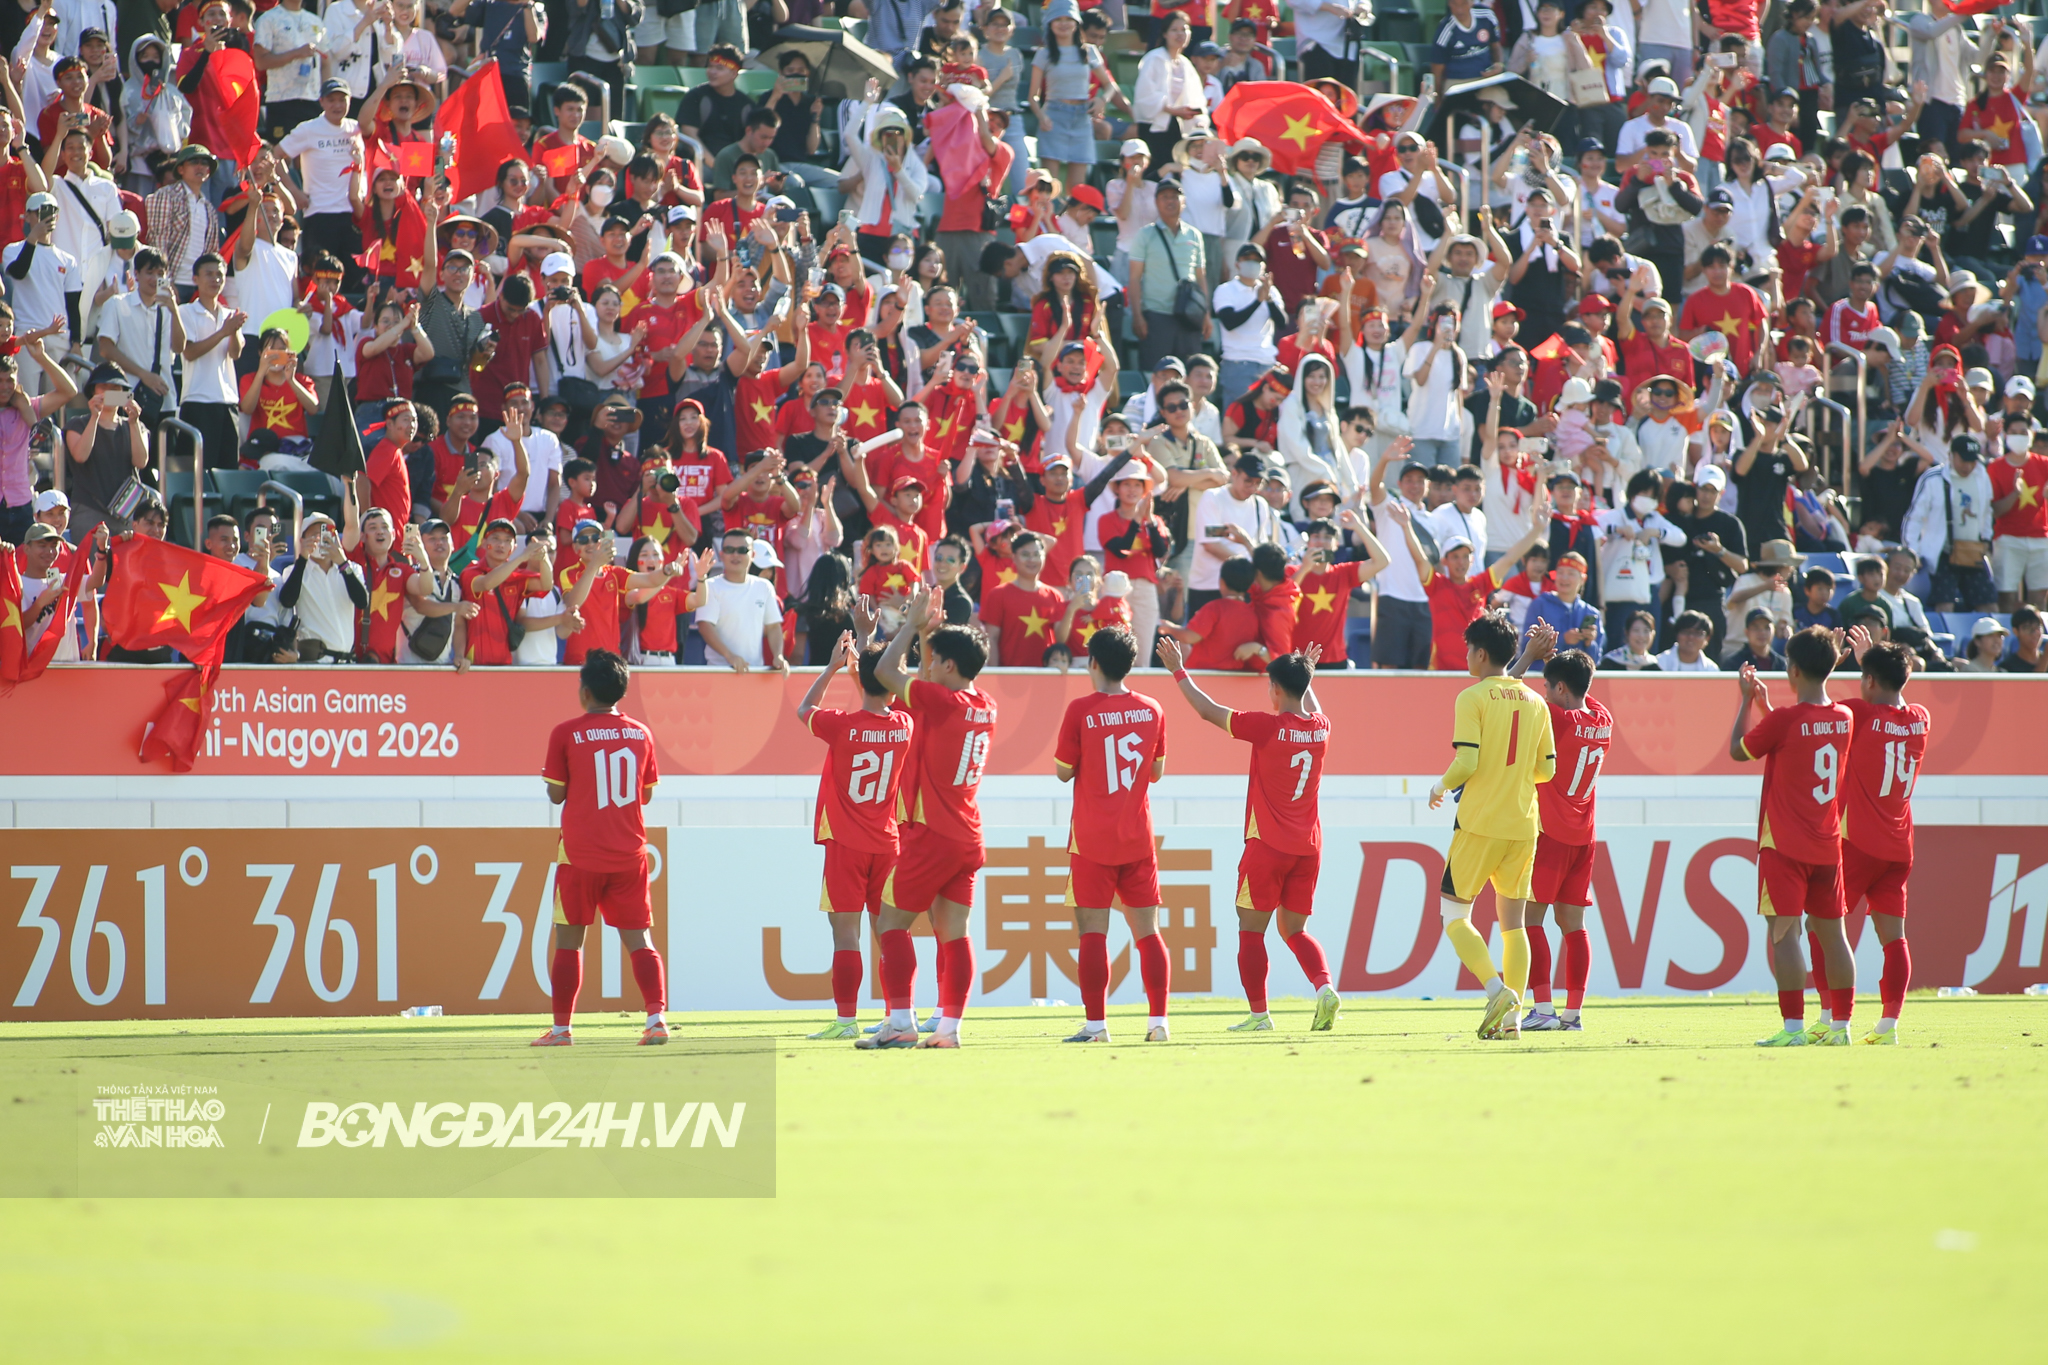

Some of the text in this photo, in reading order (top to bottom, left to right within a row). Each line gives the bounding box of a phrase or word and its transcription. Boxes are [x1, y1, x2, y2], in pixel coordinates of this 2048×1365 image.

[317, 138, 352, 149] BALMA
[673, 465, 713, 476] VIET
[211, 685, 407, 714] th Asian Games
[1489, 688, 1500, 701] C.
[1499, 688, 1517, 701] VAN
[572, 731, 585, 744] H.
[585, 727, 620, 742] QUANG
[849, 728, 860, 742] P.
[861, 730, 887, 743] MINH
[1086, 708, 1153, 729] D. TUAN PHONG
[1277, 728, 1287, 742] N.
[1801, 722, 1812, 737] N.
[1813, 721, 1834, 736] QUOC
[1871, 718, 1882, 732] N.
[1884, 721, 1910, 736] QUANG
[377, 722, 460, 758] 2026
[1506, 709, 1520, 767] 1
[593, 746, 637, 810] 10
[848, 749, 894, 804] 21
[952, 739, 991, 787] 19
[1104, 731, 1144, 795] 15
[1290, 749, 1313, 802] 7
[1567, 745, 1605, 800] 17
[1812, 742, 1838, 805] 9
[1879, 740, 1917, 799] 14
[1337, 836, 1868, 992] DNS
